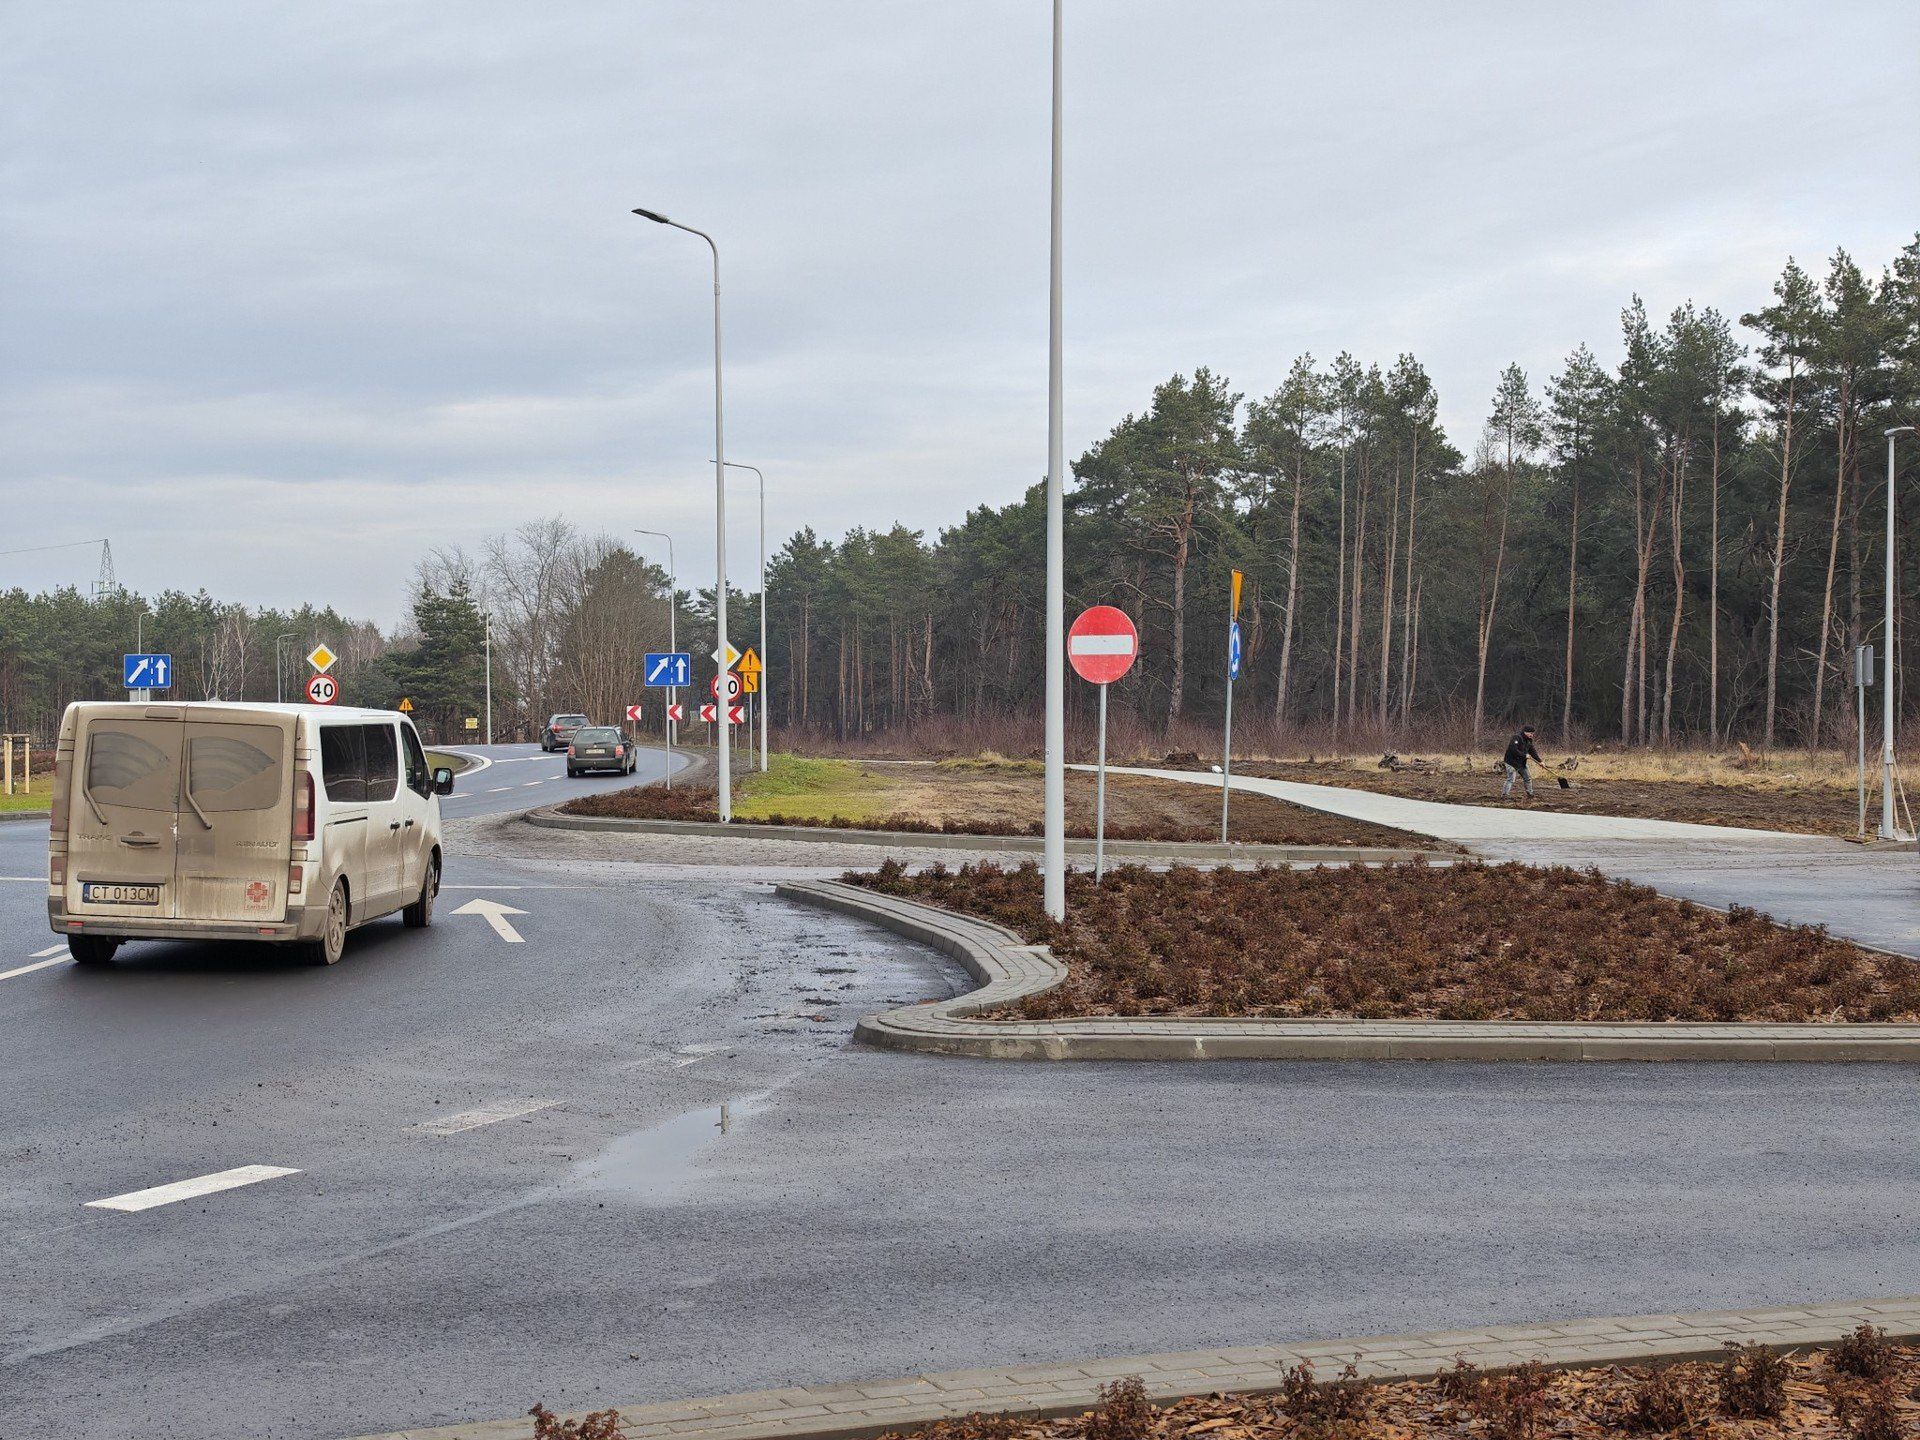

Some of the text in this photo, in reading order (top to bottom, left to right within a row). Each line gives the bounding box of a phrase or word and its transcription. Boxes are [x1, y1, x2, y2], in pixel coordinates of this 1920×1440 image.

[311, 683, 333, 697] 40
[716, 681, 737, 694] 0
[92, 887, 155, 901] CT 013CM
